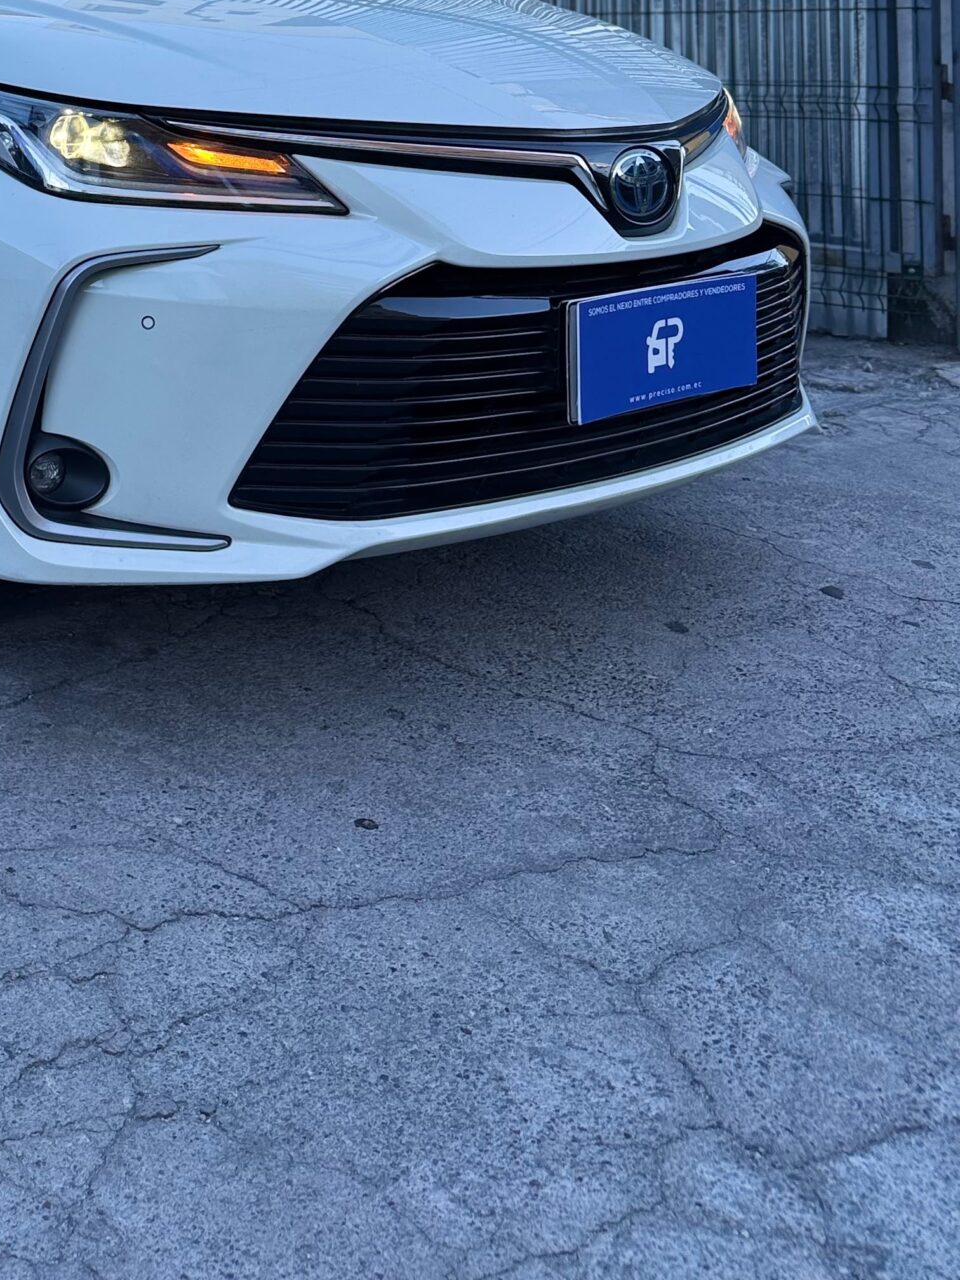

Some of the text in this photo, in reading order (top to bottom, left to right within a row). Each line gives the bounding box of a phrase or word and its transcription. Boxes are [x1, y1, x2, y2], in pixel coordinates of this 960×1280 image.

[588, 283, 746, 317] SOMOS EL NEXO ENTRE COMPRADORES Y VENDEDORES
